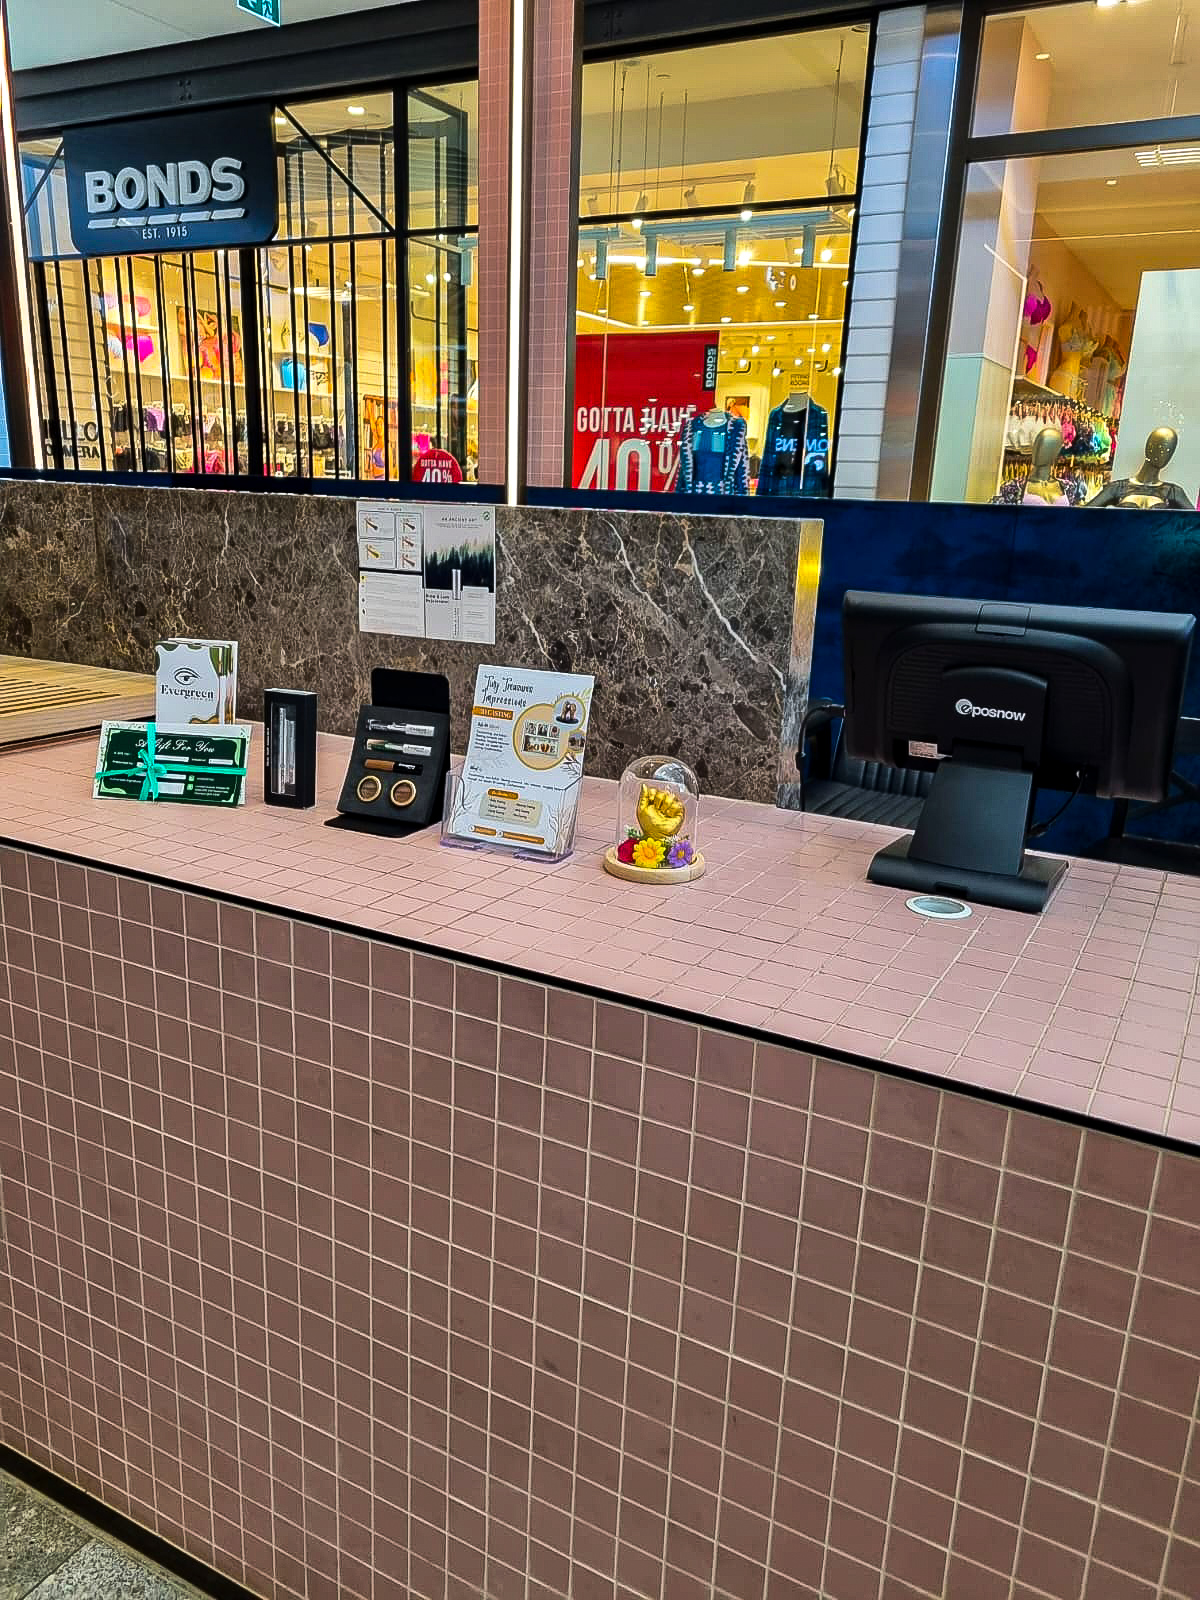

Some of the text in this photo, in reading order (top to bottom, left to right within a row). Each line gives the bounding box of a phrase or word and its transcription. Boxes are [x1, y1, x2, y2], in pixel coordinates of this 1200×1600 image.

[85, 156, 245, 213] BONDS
[142, 226, 188, 240] EST. 1915
[705, 347, 715, 388] BONDS
[576, 406, 634, 432] GOTTA
[160, 684, 214, 699] Evergreen
[955, 698, 1026, 721] eposnow
[172, 739, 192, 751] For
[195, 740, 215, 753] You
